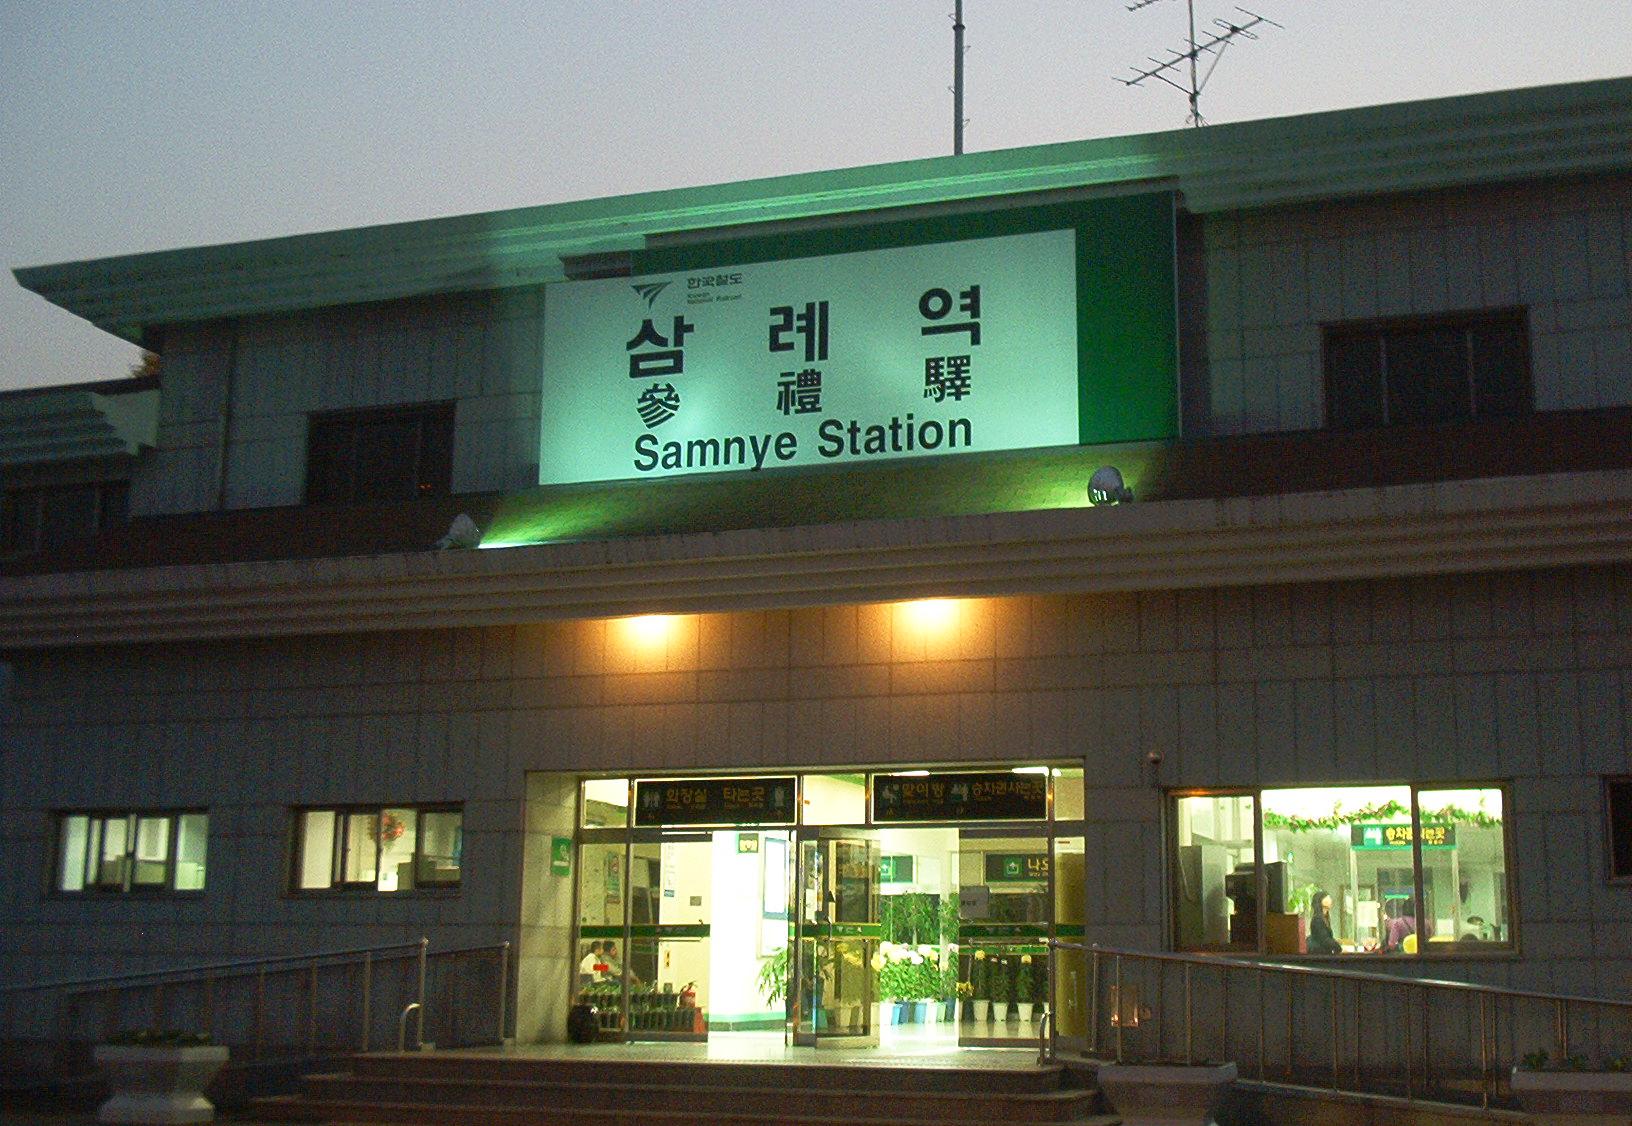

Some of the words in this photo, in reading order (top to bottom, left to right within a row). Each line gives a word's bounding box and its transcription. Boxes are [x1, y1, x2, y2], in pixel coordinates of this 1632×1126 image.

[686, 273, 742, 289] 한국철도
[634, 433, 797, 472] Samnye
[817, 413, 972, 458] Station
